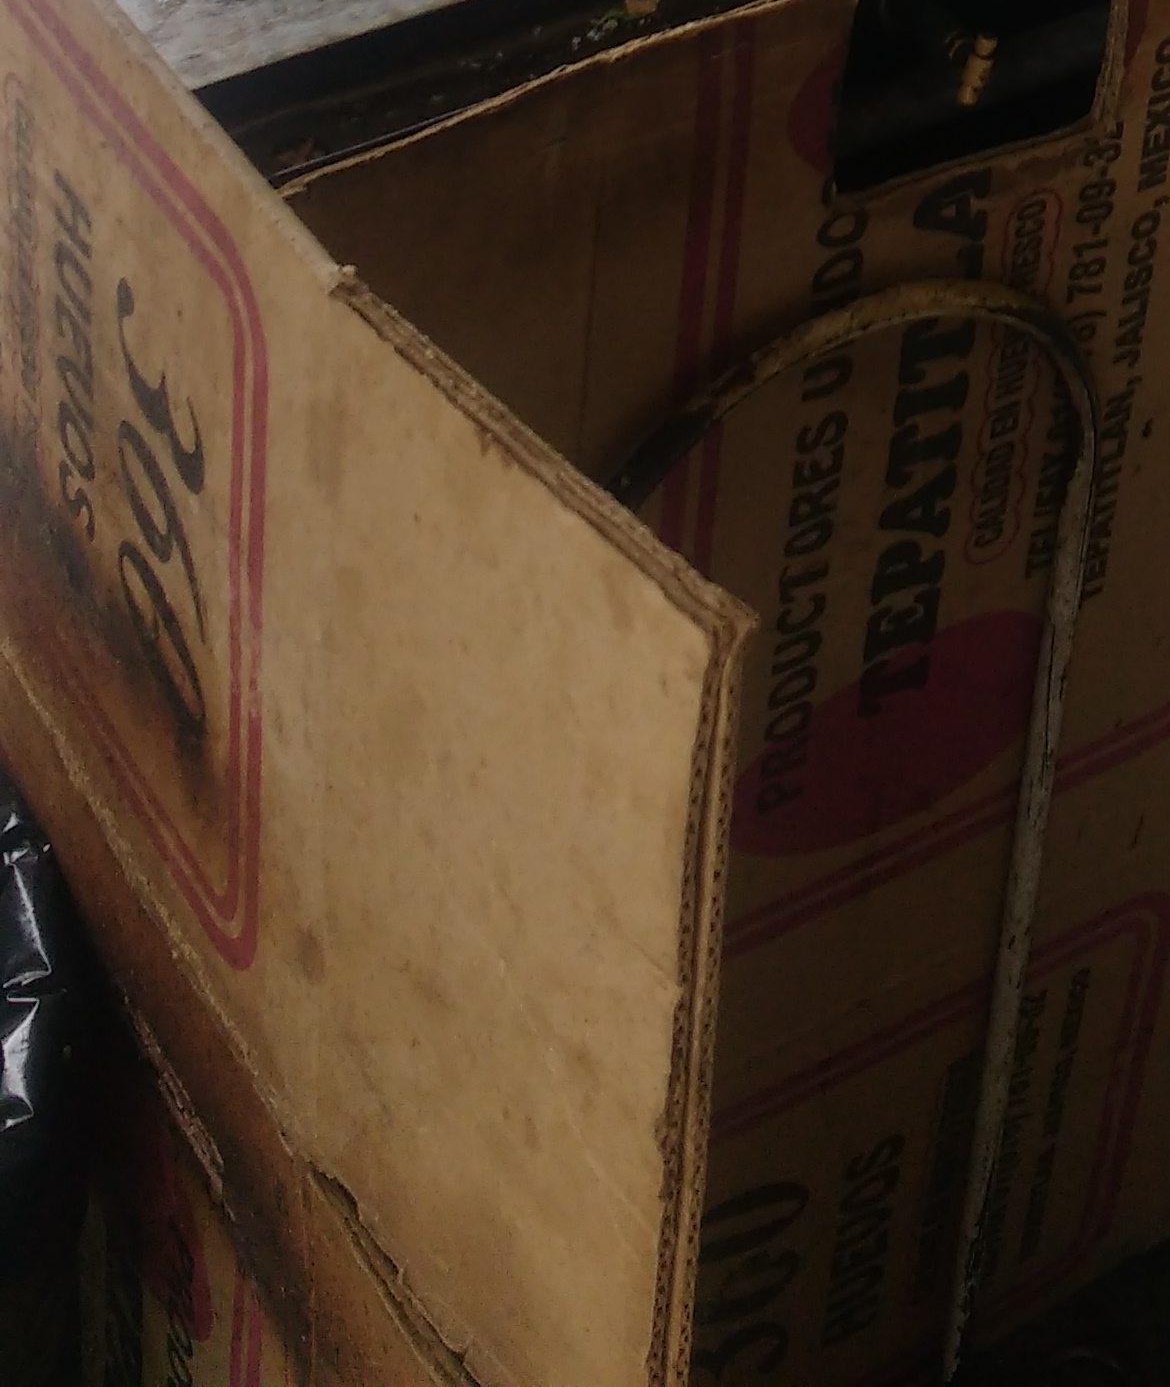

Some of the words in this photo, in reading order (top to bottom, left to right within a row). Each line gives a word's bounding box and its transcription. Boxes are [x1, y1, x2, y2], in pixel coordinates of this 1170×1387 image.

[799, 177, 868, 403] UIDO
[1008, 199, 1047, 301] RESCO
[1111, 194, 1170, 370] JALISCO,
[53, 169, 96, 542] HUEVOS
[989, 401, 1021, 440] EN
[971, 440, 1015, 548] CALIDAD
[756, 410, 848, 813] PRODUCTORES
[820, 1131, 906, 1349] HUEVOS
